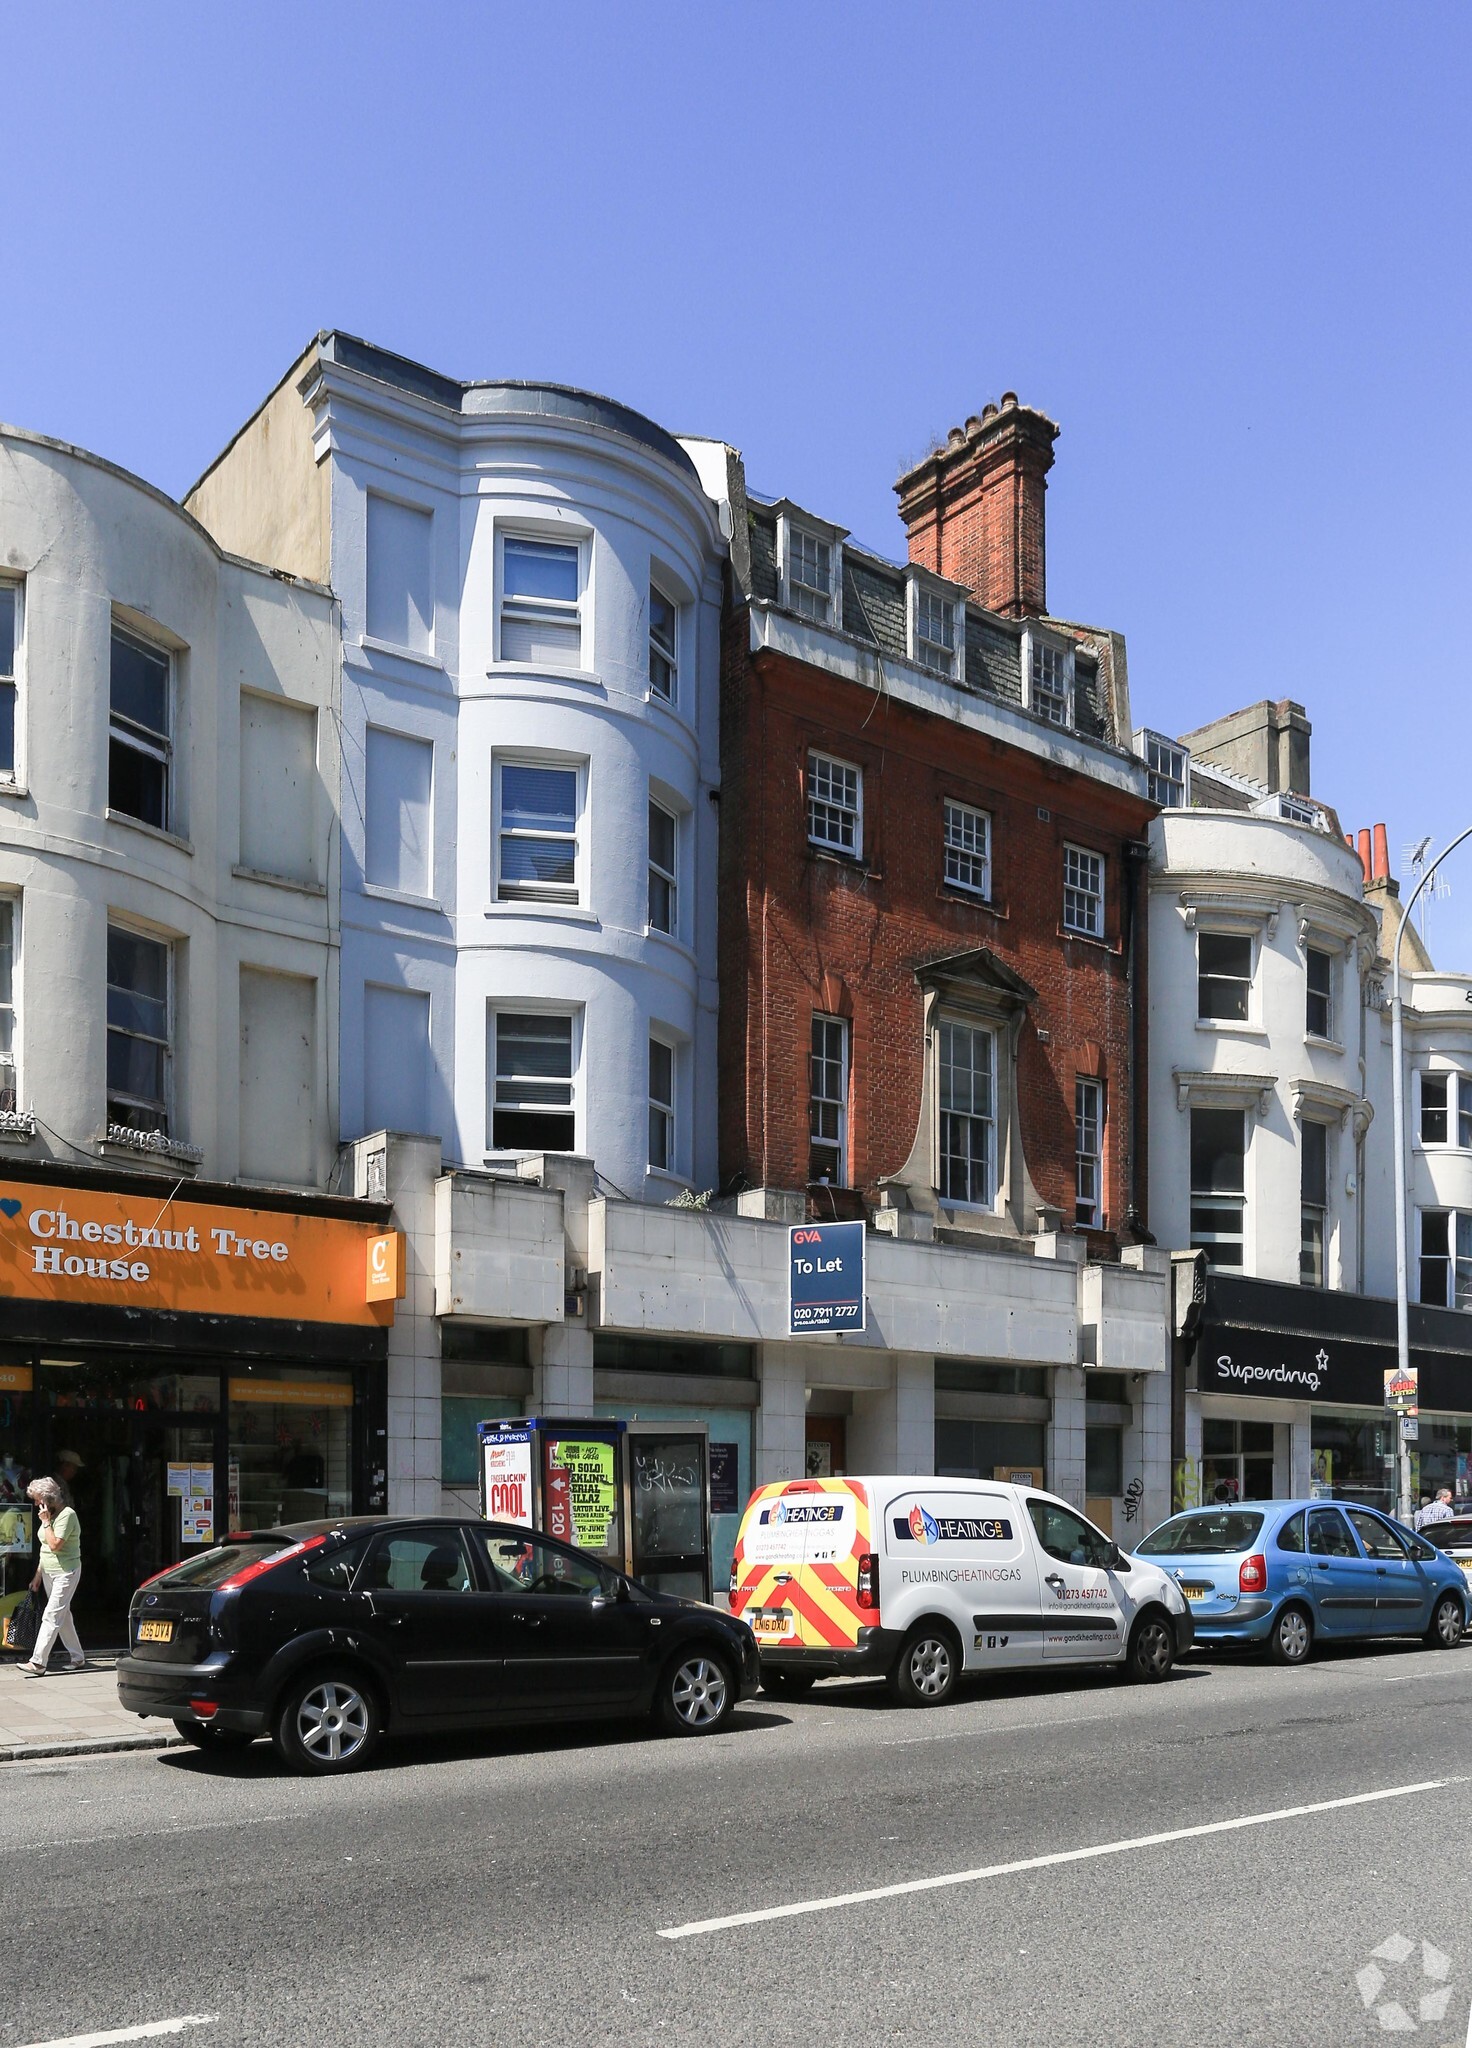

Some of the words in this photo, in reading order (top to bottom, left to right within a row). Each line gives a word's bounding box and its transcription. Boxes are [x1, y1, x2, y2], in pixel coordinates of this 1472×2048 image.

[28, 1209, 200, 1252] Chestnut
[211, 1228, 289, 1262] Tree
[794, 1231, 822, 1244] GVA
[31, 1245, 150, 1282] House
[793, 1259, 813, 1274] To
[817, 1257, 843, 1273] Let
[794, 1309, 811, 1319] 020
[813, 1307, 833, 1317] 7911
[835, 1306, 858, 1317] 2727
[1217, 1355, 1320, 1391] Superdrug
[570, 1484, 600, 1493] ERIAL
[491, 1483, 527, 1518] COOL
[572, 1494, 600, 1504] ILLAZ
[552, 1503, 565, 1535] 120
[786, 1507, 828, 1522] HEATING
[576, 1525, 605, 1533] TH-JUNE
[939, 1521, 995, 1538] HEATING
[994, 1521, 1004, 1538] LTD
[1057, 1589, 1080, 1599] 01273
[1081, 1588, 1108, 1599] 457742
[1048, 1602, 1116, 1611] info@gandkheating.co.uk
[755, 1618, 770, 1631] LN16
[771, 1620, 787, 1631] DXU
[1048, 1631, 1119, 1643] www.gandkheating.co.uk
